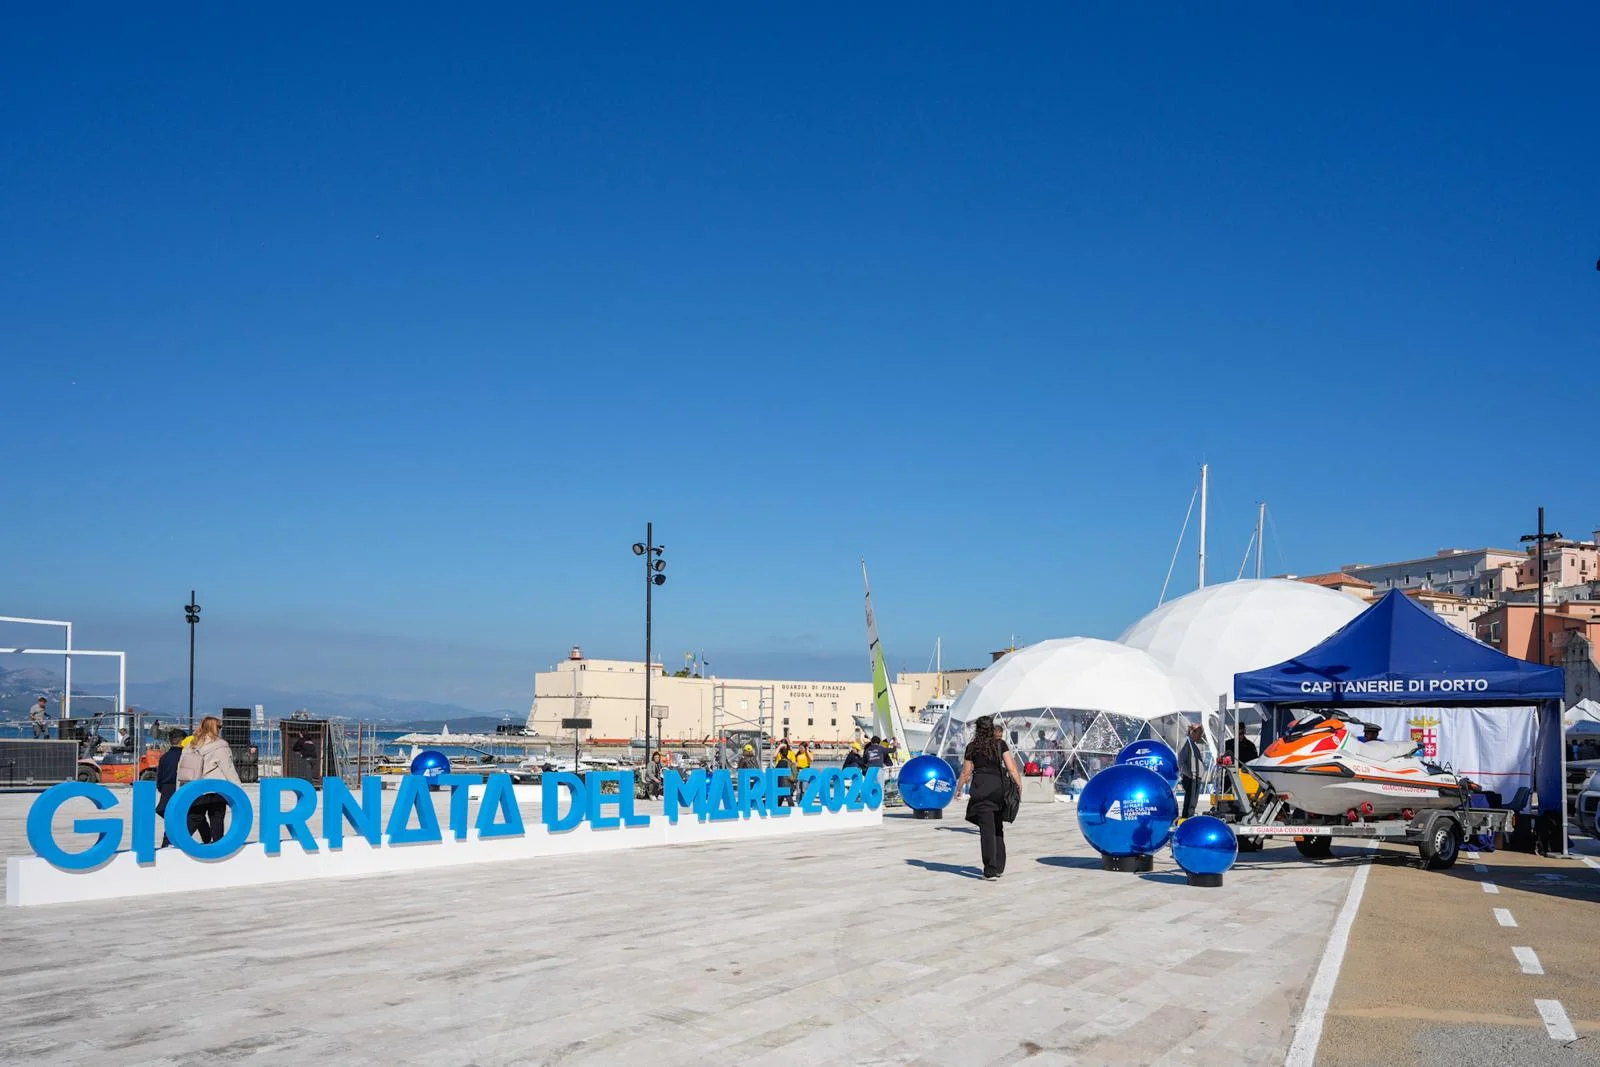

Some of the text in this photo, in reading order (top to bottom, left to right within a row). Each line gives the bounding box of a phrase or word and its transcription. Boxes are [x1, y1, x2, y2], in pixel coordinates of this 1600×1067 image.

[1301, 679, 1488, 693] CAPITANERIE DI PORTO
[27, 767, 883, 873] GIORNATA DEL MARE 2026
